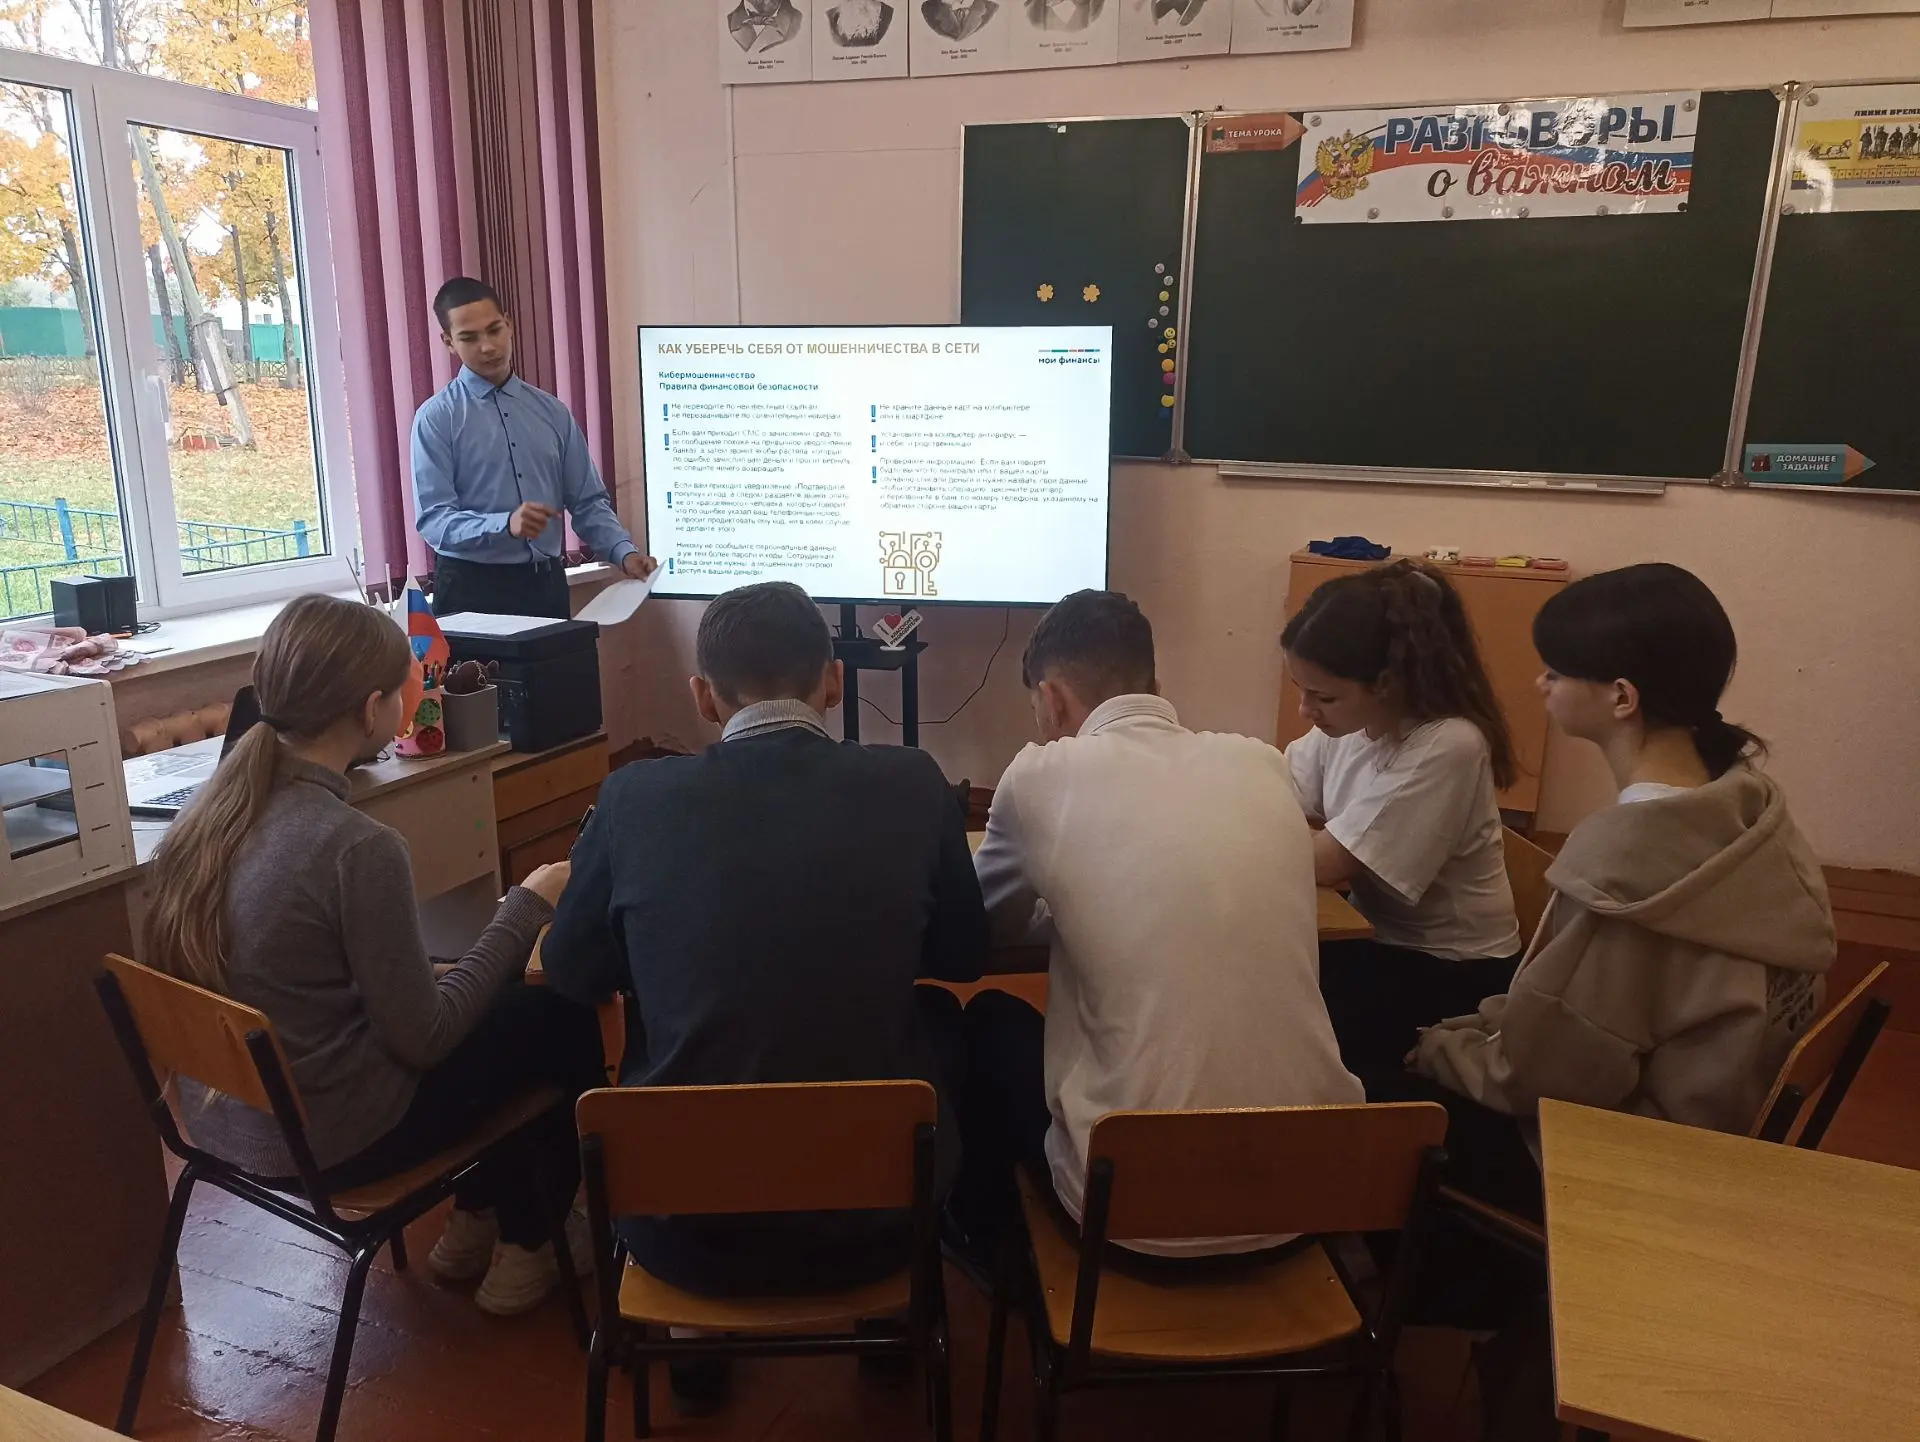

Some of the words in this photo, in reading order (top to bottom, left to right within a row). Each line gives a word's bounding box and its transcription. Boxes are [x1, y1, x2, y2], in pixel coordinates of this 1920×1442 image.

[1253, 128, 1283, 137] УРОКА
[1427, 169, 1458, 197] о
[659, 343, 682, 354] КАК
[686, 343, 744, 354] УБЕРЕЧЬ
[747, 343, 782, 354] СЕБЯ
[786, 343, 803, 354] ОТ
[807, 343, 928, 354] МОШЕННИЧЕСТВА
[932, 343, 941, 354] В
[945, 343, 980, 354] СЕТИ
[1058, 355, 1100, 366] финансы
[659, 370, 756, 381] Кибермошенничество
[660, 383, 697, 392] Правила
[699, 382, 754, 393] финансовой
[757, 382, 819, 393] безопасности
[1776, 454, 1837, 463] ДОМАШНЕЕ
[1781, 463, 1830, 471] ЗАДАНИЕ
